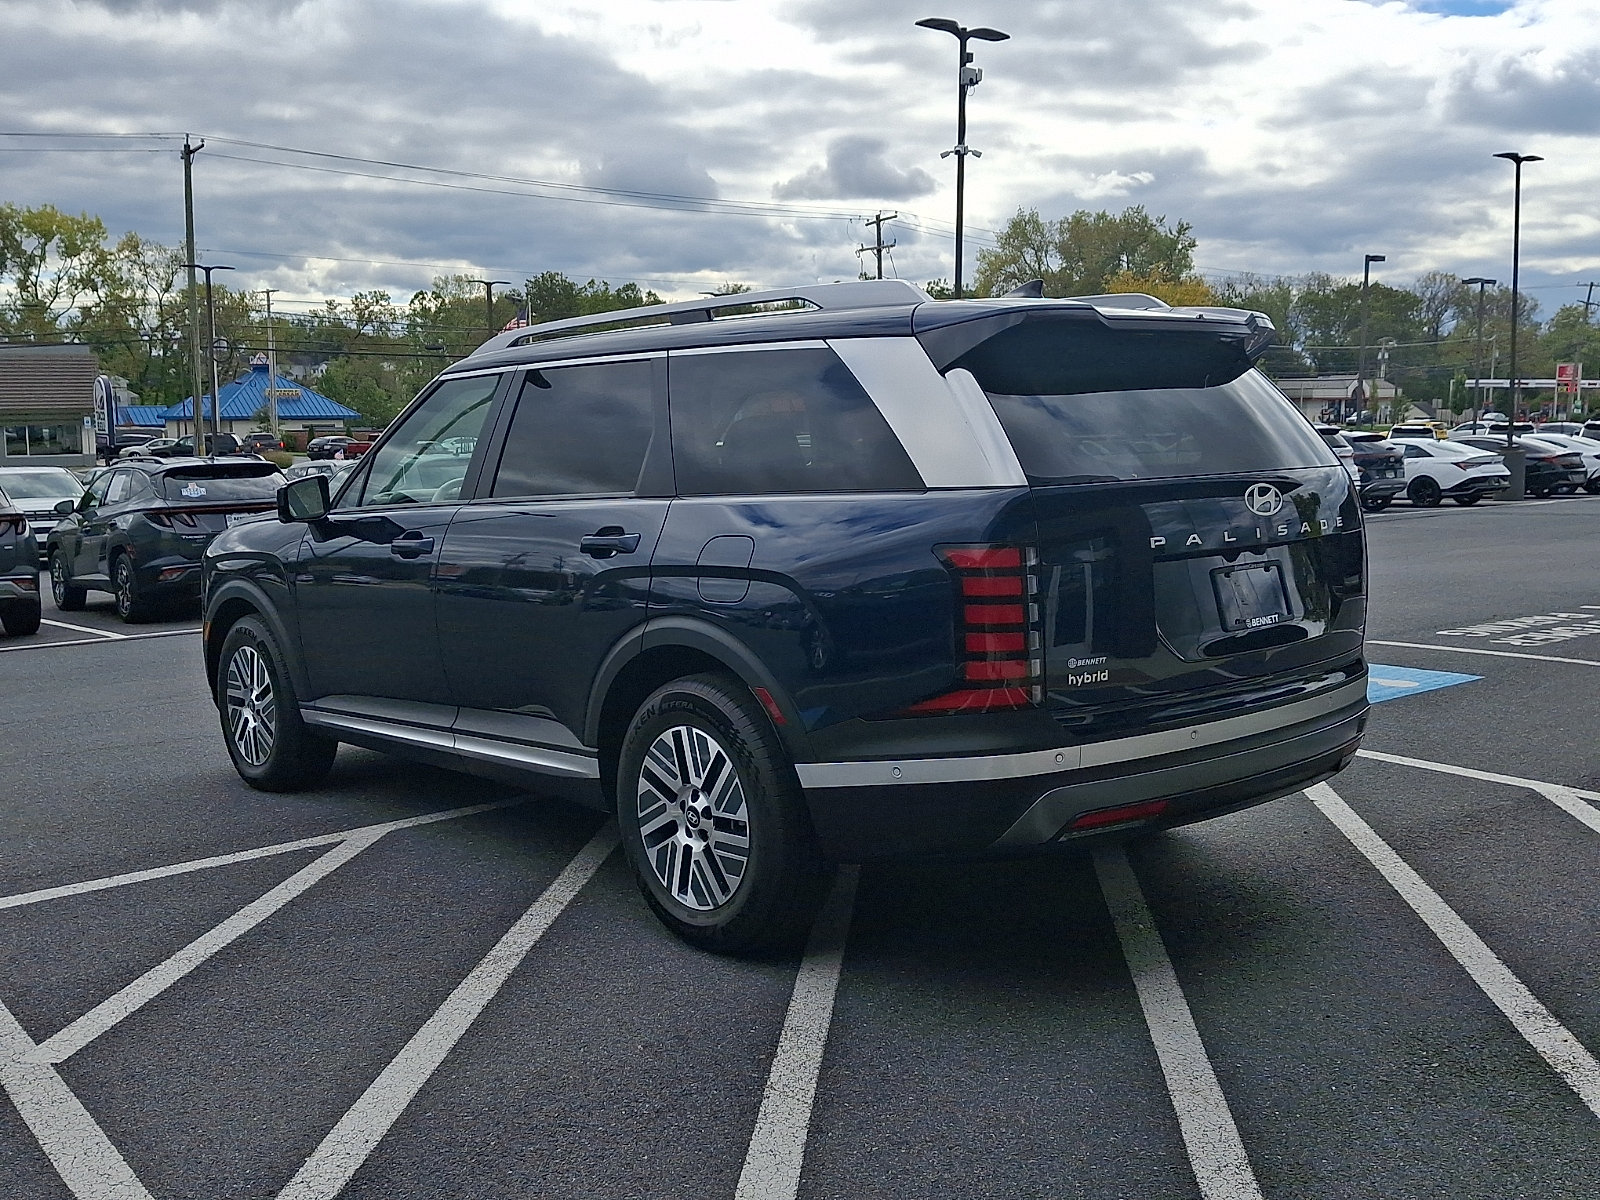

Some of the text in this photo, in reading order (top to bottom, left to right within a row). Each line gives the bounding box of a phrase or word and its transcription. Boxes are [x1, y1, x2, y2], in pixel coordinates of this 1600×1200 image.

[1150, 516, 1344, 549] PALISADE
[1251, 613, 1279, 627] BENNETT
[1077, 656, 1108, 667] BENNETT
[1068, 669, 1109, 687] hybrid
